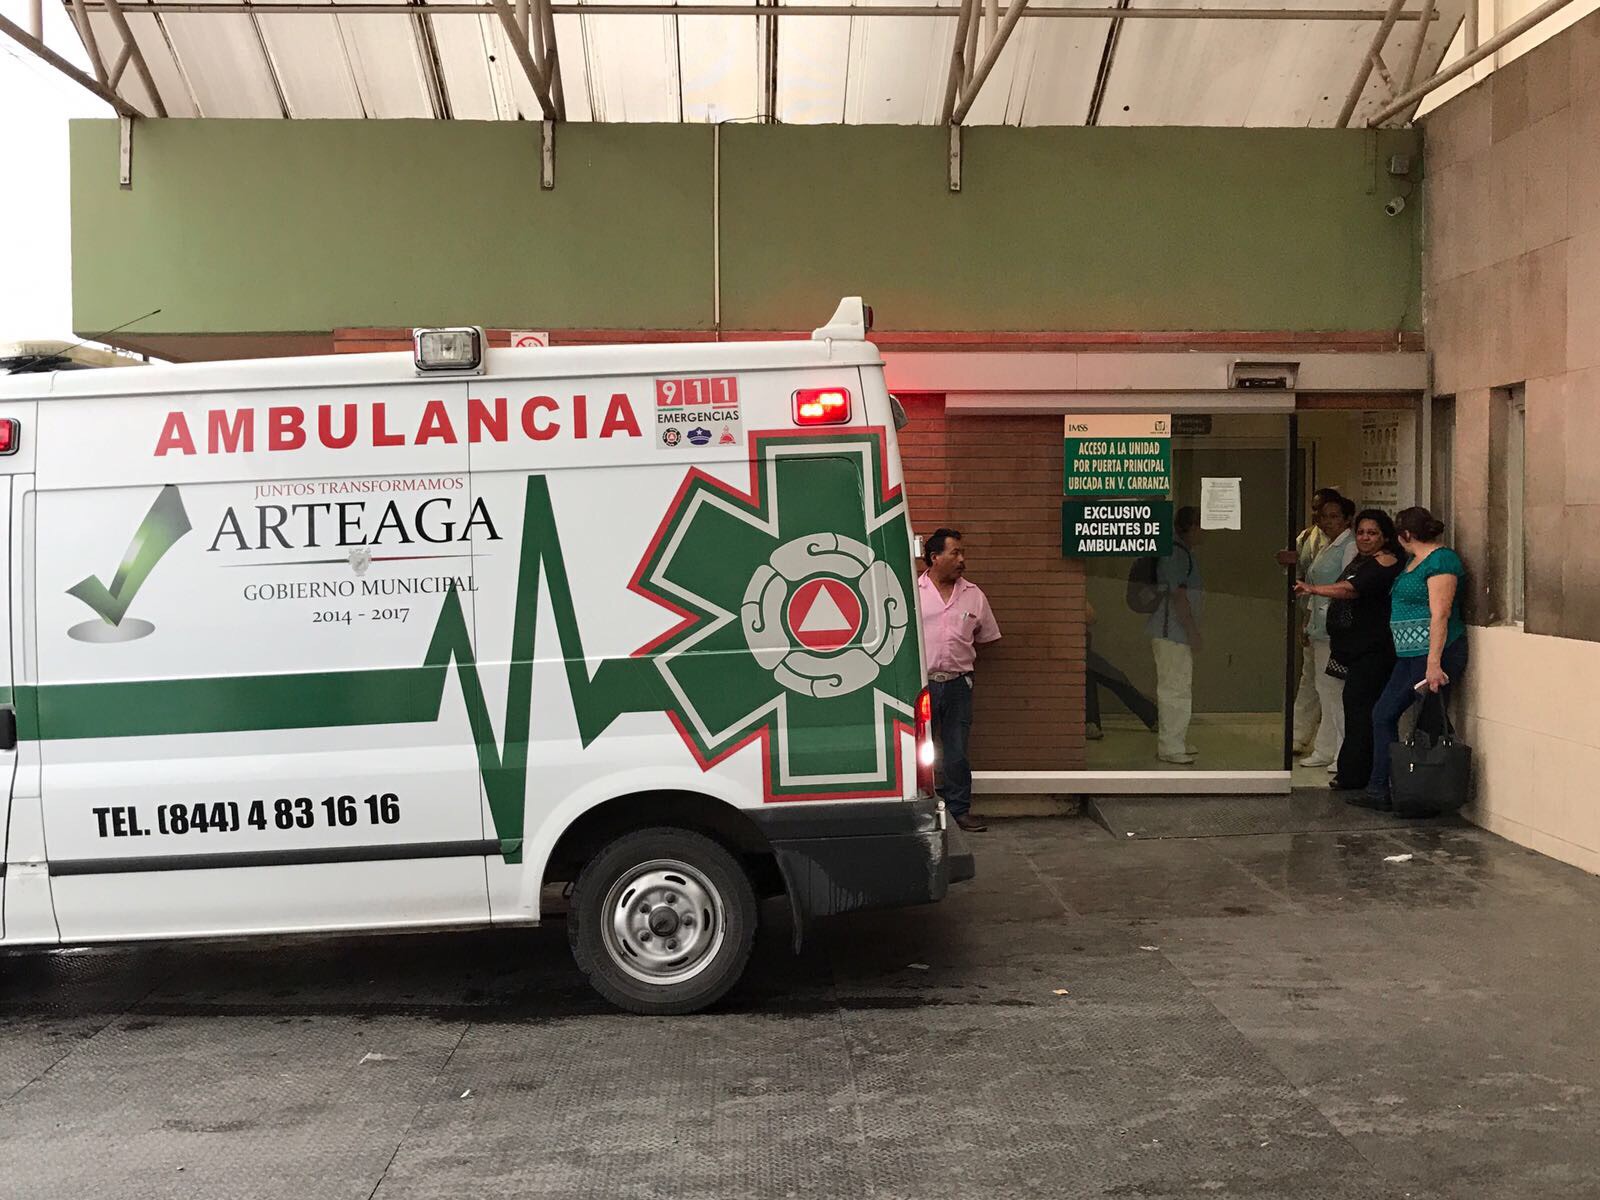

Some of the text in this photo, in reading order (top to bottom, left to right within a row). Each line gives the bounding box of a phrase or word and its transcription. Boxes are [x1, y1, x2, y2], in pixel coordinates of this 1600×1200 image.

[662, 379, 730, 404] 911
[657, 410, 740, 424] EMERGENCIAS
[153, 393, 643, 457] AMBULANCIA
[1068, 424, 1089, 432] IMSS
[1078, 441, 1160, 455] ACCESO A LA UNIDAD
[1073, 459, 1165, 473] POR PUERTA PRINCIPAL
[254, 477, 464, 500] JUNTOS TRANSFORMAMOS
[1068, 476, 1170, 490] UBICADA EN V. CARRANZA
[1084, 505, 1152, 520] EXCLUSIVO
[206, 496, 503, 552] ARTEAGA
[1075, 522, 1161, 536] PACIENTES DE
[1077, 538, 1158, 552] AMBULANCIA
[243, 575, 479, 601] GOBIERNO MUNICIPAL
[312, 609, 353, 626] 2014
[371, 607, 410, 624] 2017
[92, 792, 401, 838] TEL. (844) 4 83 16 16
